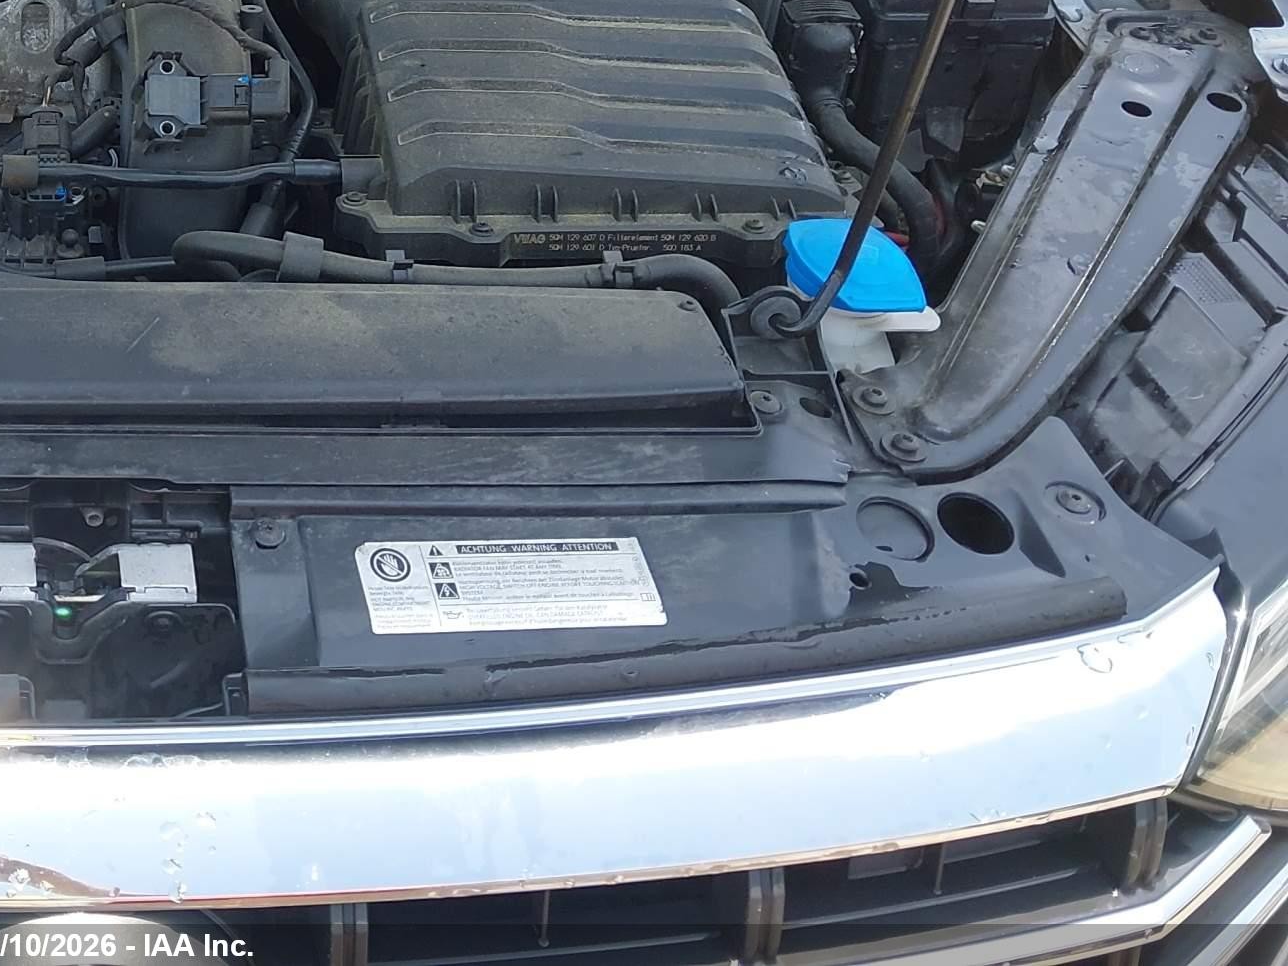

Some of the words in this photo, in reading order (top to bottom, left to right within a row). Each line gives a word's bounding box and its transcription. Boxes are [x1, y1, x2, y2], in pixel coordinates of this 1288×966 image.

[461, 544, 507, 553] ACHTUNG
[511, 544, 557, 552] WARNING
[562, 543, 612, 551] ATTENTION
